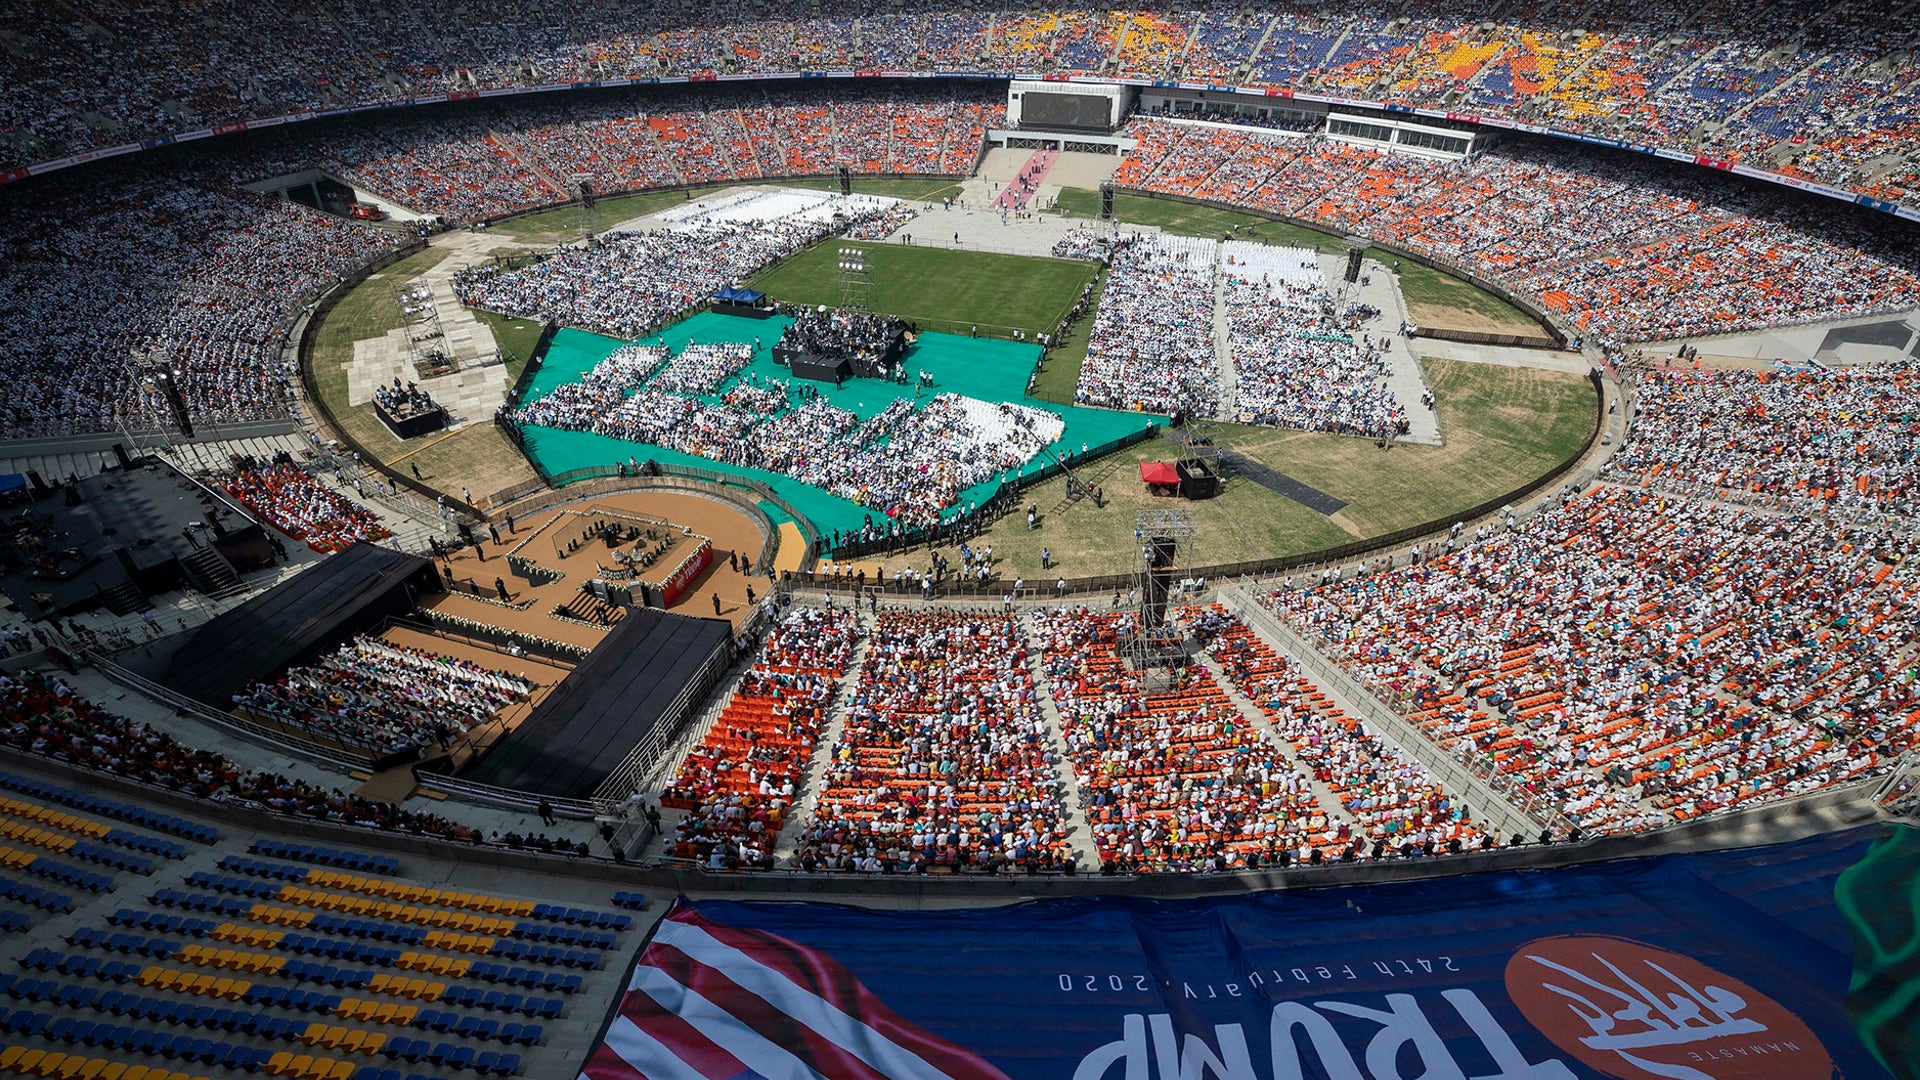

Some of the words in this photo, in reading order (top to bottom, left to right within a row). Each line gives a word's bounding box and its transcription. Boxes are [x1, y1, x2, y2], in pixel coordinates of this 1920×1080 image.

[1372, 956, 1460, 977] 24th
[1058, 973, 1149, 992] 2020
[1072, 988, 1579, 1080] TRUMP
[1687, 1041, 1800, 1062] NAMASTE
